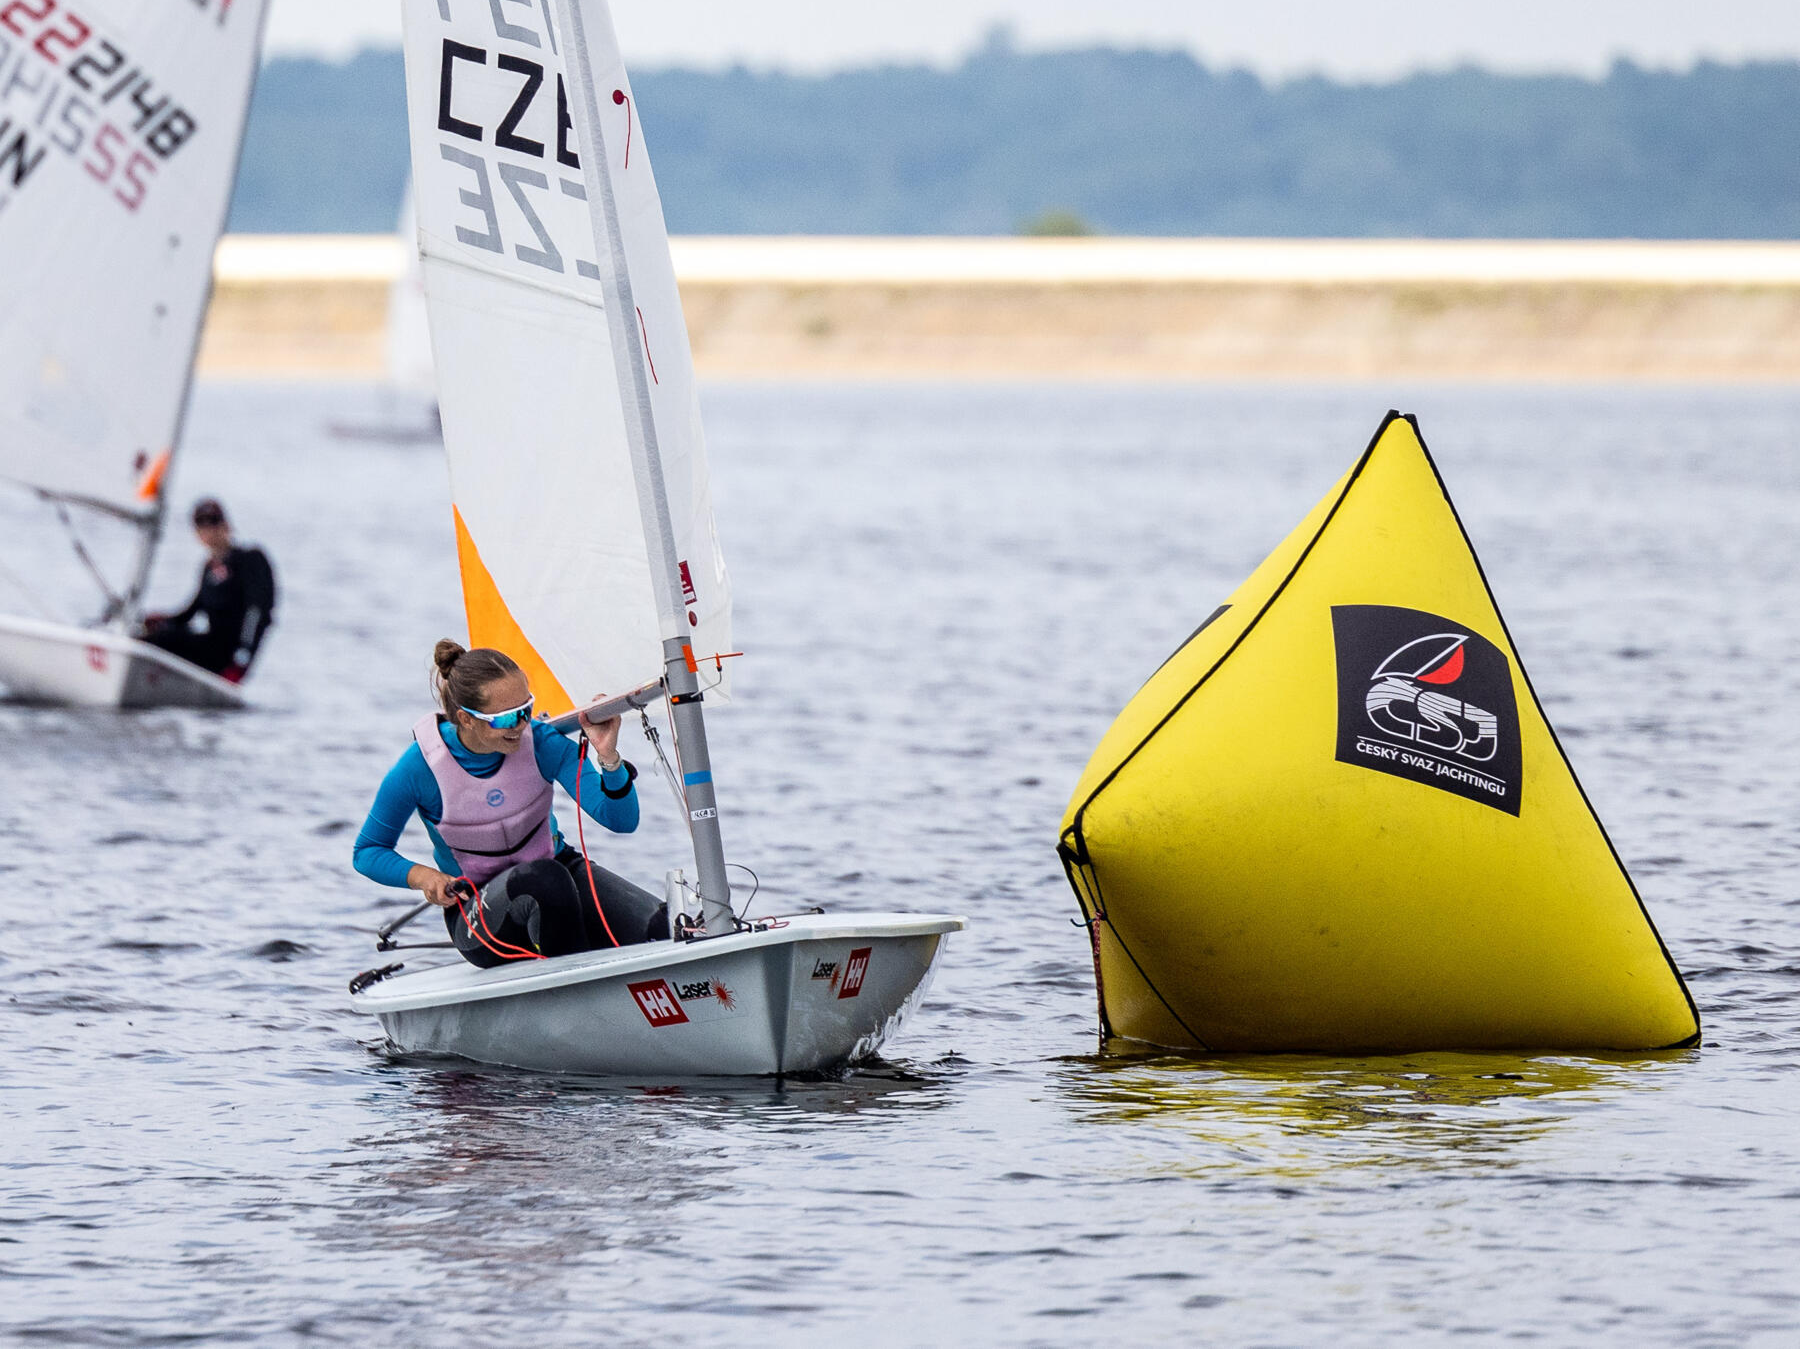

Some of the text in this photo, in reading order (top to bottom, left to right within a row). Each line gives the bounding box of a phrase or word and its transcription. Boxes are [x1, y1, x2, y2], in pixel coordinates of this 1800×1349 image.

[1355, 739, 1506, 797] ČESKÝ SVAZ JACHTINGU
[811, 957, 867, 990] Laser HH
[636, 980, 712, 1020] HH Laser
